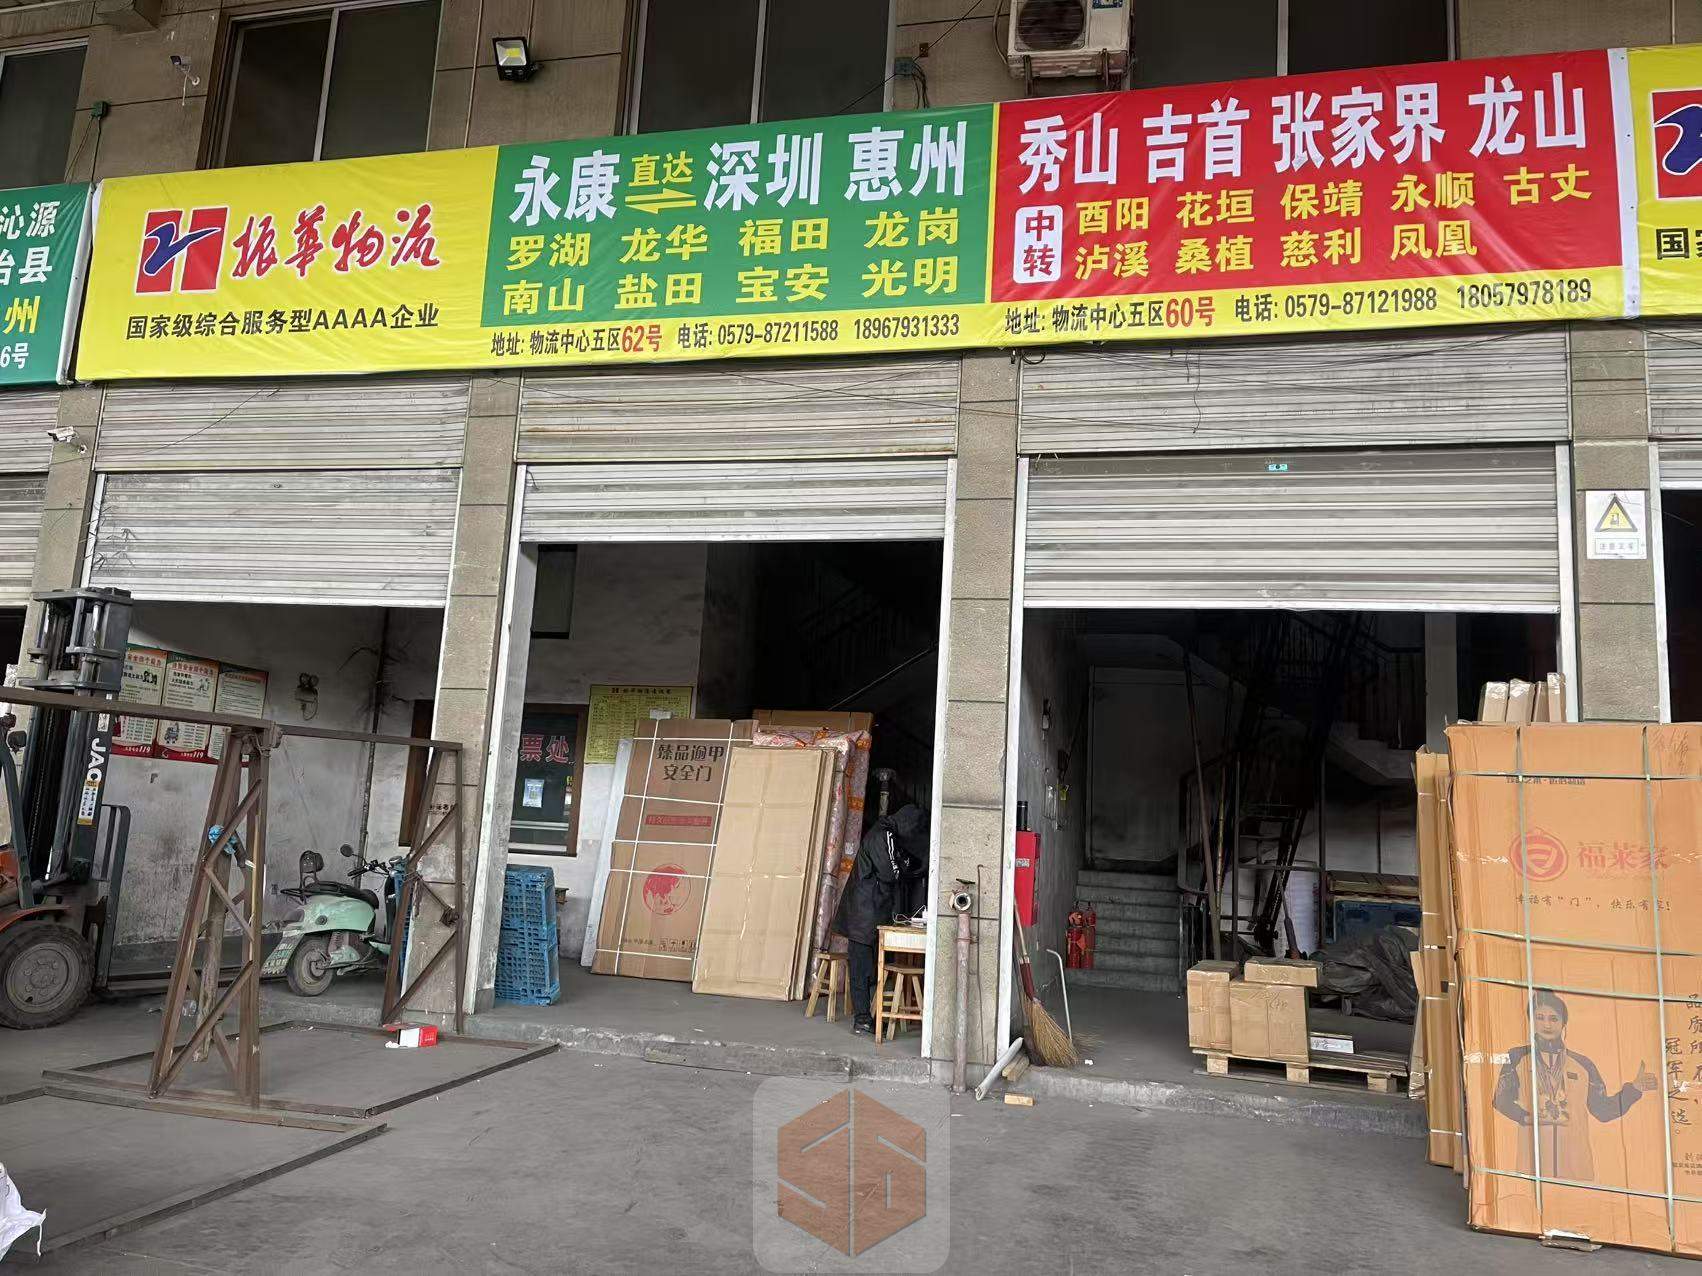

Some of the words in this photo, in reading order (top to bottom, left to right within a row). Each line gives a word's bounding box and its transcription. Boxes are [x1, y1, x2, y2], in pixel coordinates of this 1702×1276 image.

[1018, 112, 1118, 194] 秀山
[1142, 96, 1250, 184] 吉首
[1271, 82, 1446, 173] 张家界
[1468, 72, 1586, 157] 龙山
[509, 150, 620, 226] 永康
[628, 151, 693, 187] 直达
[703, 133, 823, 211] 深圳
[844, 121, 967, 201] 惠州
[0, 201, 60, 240] 沁源
[1075, 197, 1149, 235] 酉阳
[1176, 189, 1255, 228] 花垣
[1280, 179, 1364, 220] 保靖
[1391, 171, 1475, 213] 永顺
[1503, 163, 1592, 206] 古丈
[506, 232, 591, 271] 罗湖
[619, 223, 708, 263] 龙华
[738, 218, 828, 256] 福田
[864, 207, 958, 249] 龙岗
[1023, 210, 1056, 277] 中转
[1074, 240, 1149, 280] 泸溪
[1175, 234, 1254, 274] 桑植
[1279, 226, 1361, 267] 慈利
[1390, 219, 1478, 261] 凤凰
[1656, 227, 1702, 260] 国
[502, 277, 585, 316] 南山
[614, 272, 702, 309] 盐田
[735, 263, 829, 304] 宝安
[861, 255, 958, 298] 光明
[1457, 276, 1592, 309] 18057978189
[3, 296, 41, 334] 州
[126, 303, 440, 341] 国家级综合服务型AAAA企业
[854, 313, 960, 341] 18967931333
[662, 763, 712, 782] 安全门
